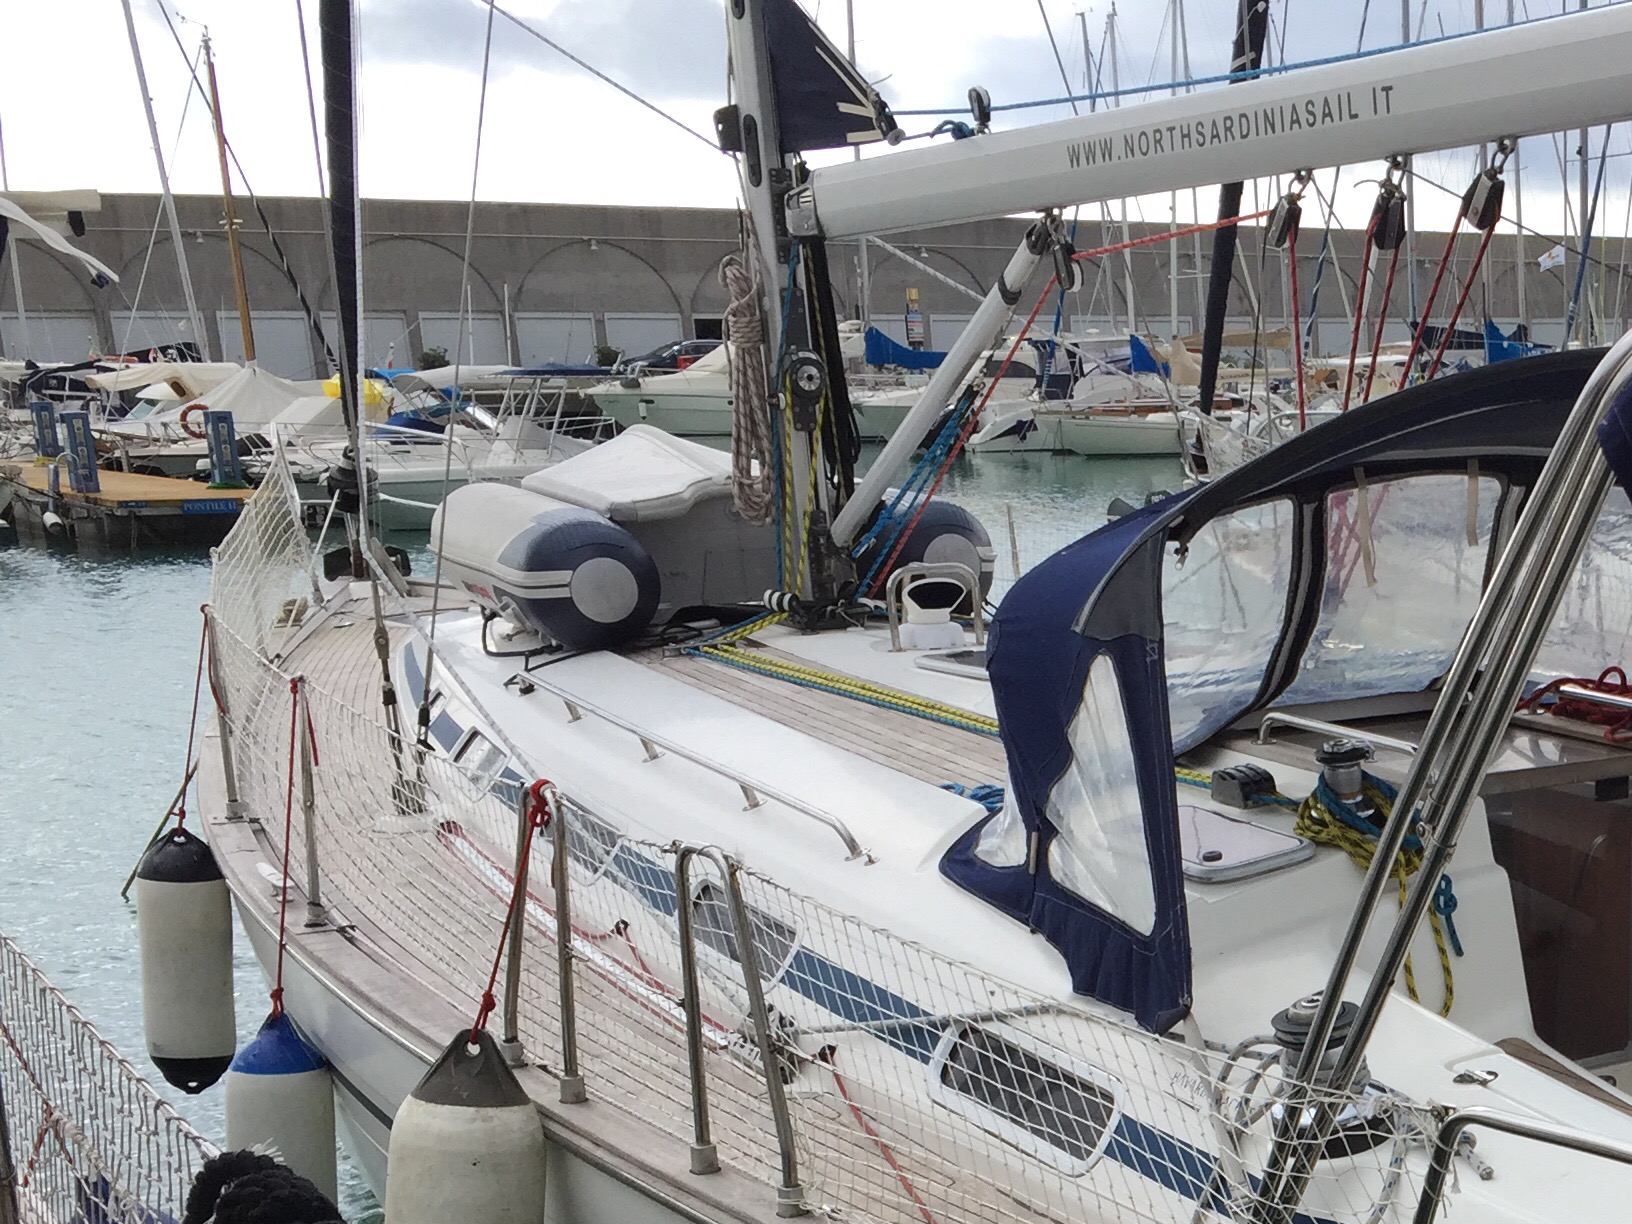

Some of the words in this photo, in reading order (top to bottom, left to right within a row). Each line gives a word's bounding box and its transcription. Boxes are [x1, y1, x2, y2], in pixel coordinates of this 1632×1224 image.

[1067, 91, 1359, 169] WWW.NORTHSARDINIASAIL
[1372, 85, 1394, 116] IT
[183, 502, 227, 511] PONTILE
